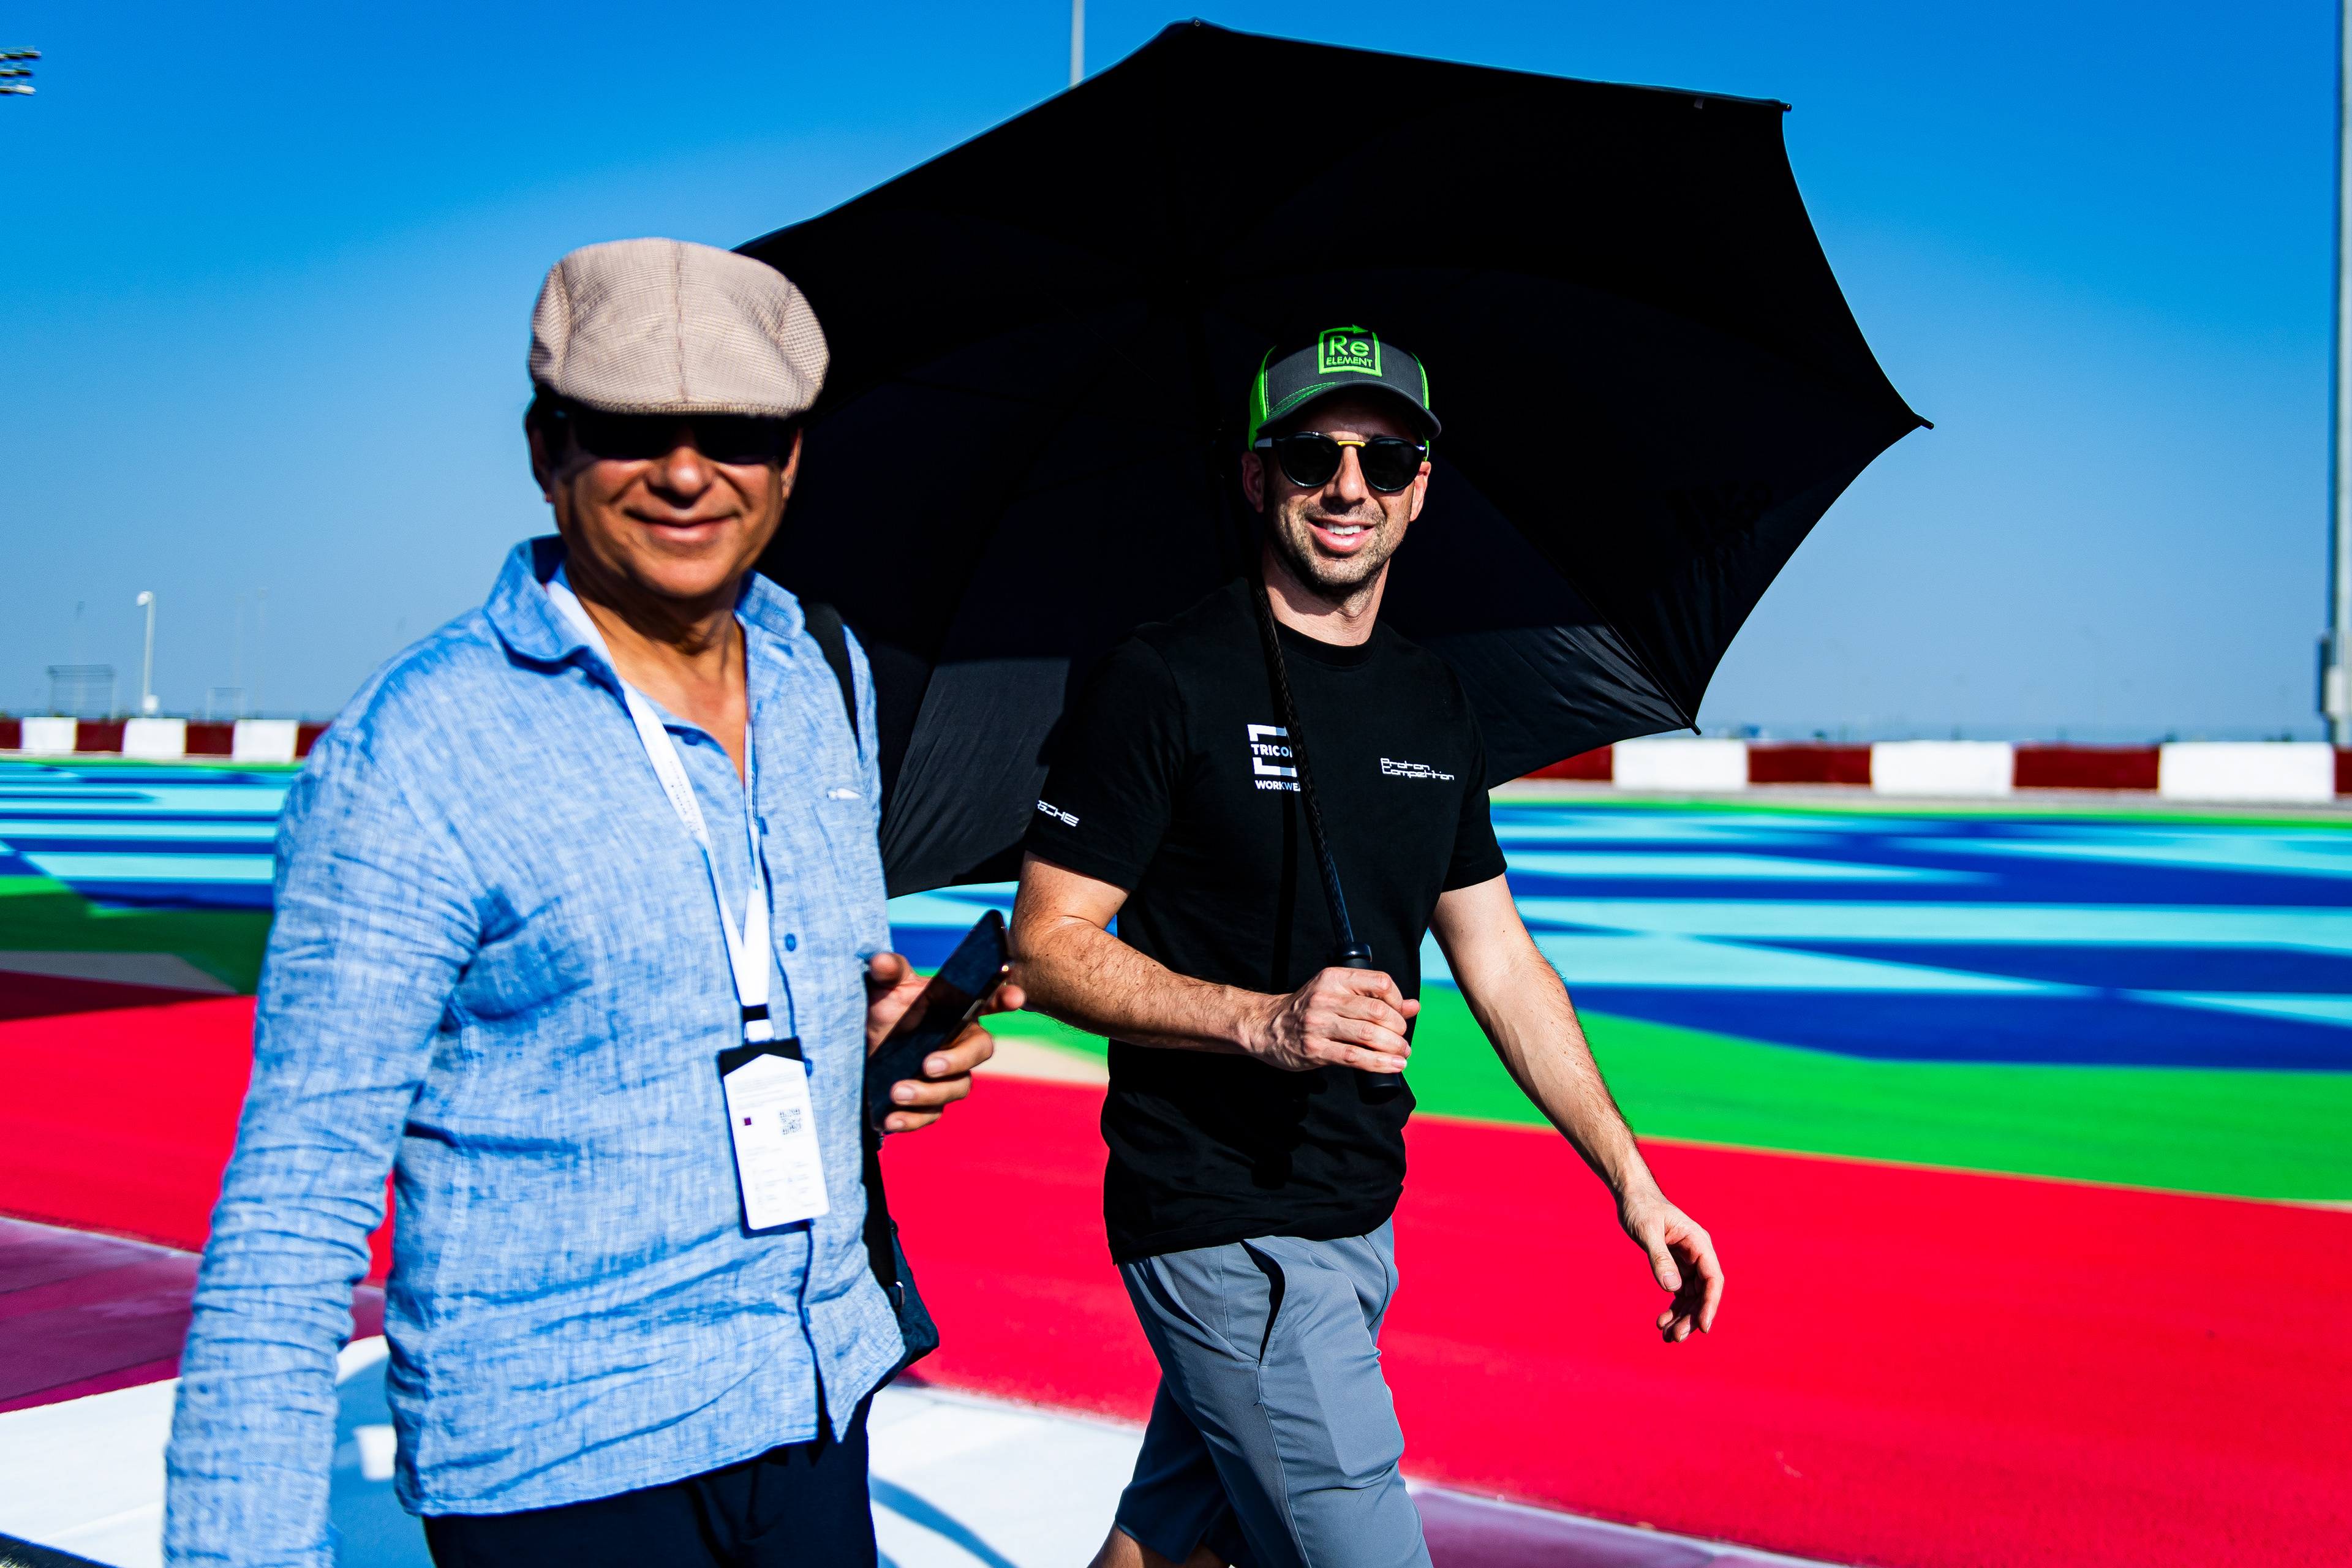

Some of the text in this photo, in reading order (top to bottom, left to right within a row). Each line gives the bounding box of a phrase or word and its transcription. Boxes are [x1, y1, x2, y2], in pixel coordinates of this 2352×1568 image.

[1329, 336, 1370, 356] Re
[1326, 357, 1373, 368] ELEMENT
[1382, 766, 1455, 780] Competition
